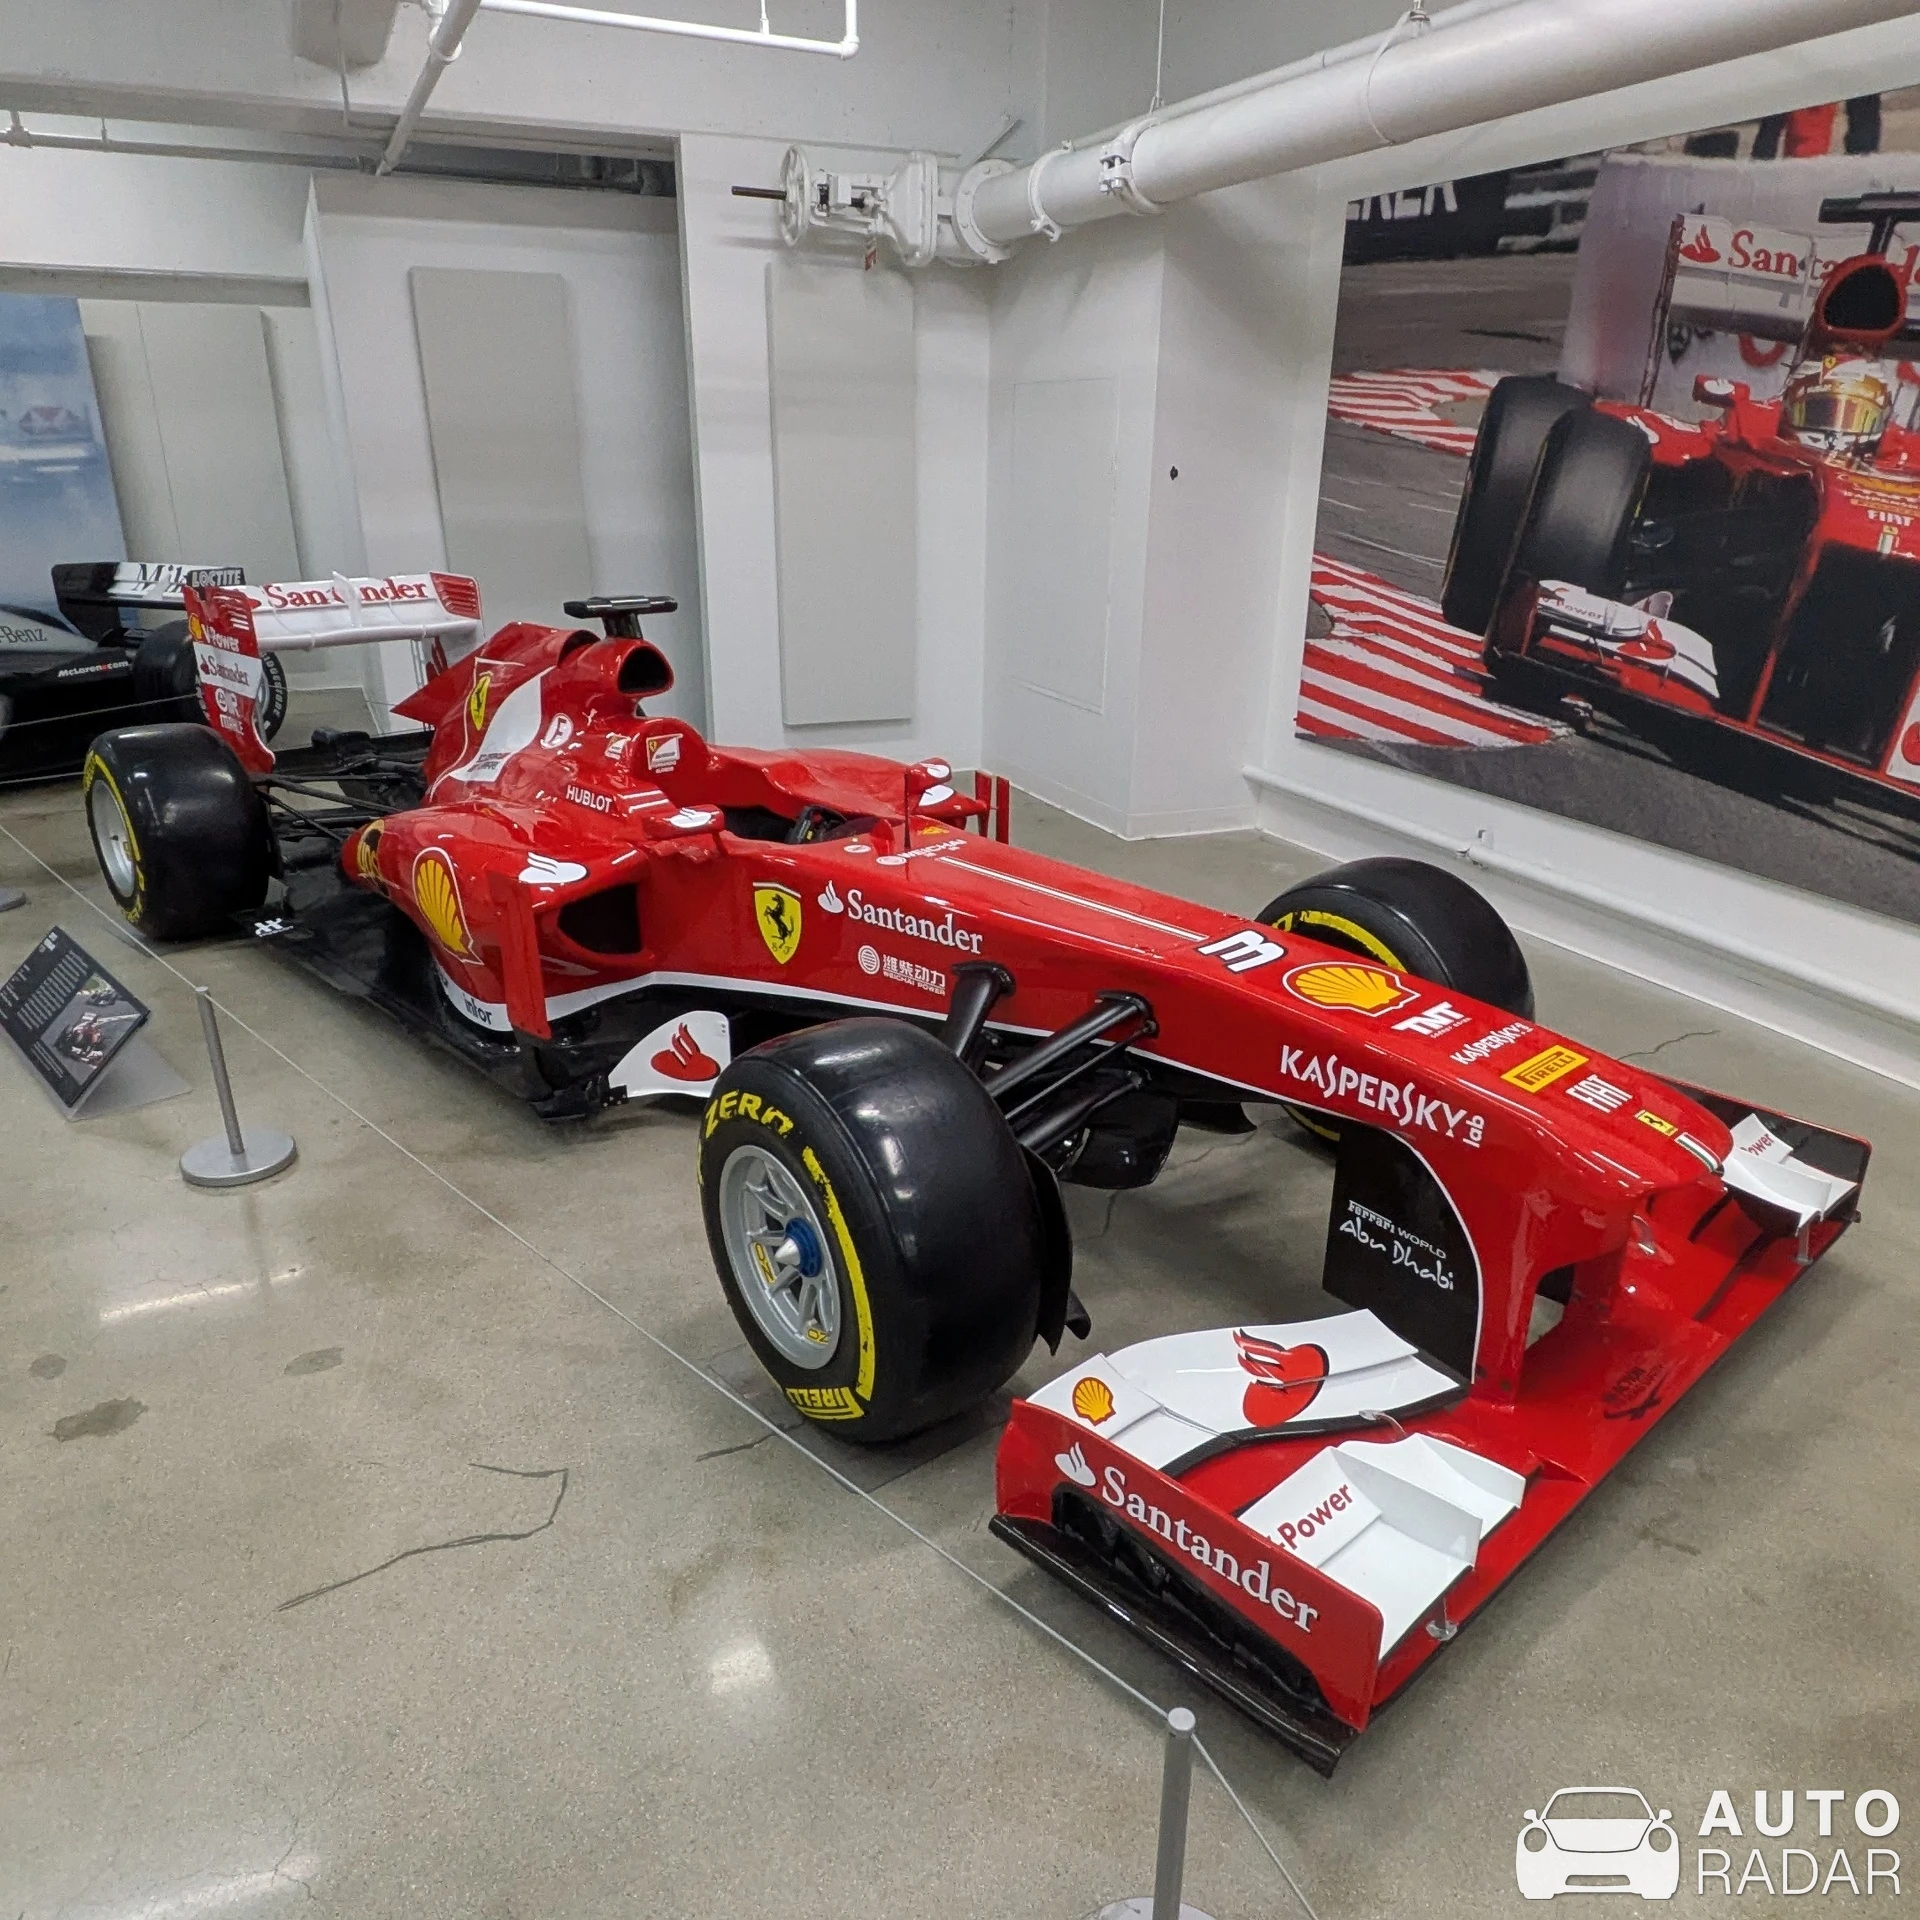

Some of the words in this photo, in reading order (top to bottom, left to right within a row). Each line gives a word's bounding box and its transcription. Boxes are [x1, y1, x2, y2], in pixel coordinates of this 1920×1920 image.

[192, 569, 241, 587] LOCTITE
[565, 784, 612, 813] HUBLOT
[847, 888, 983, 955] Santander
[1198, 929, 1287, 973] 3
[917, 982, 946, 996] POWER
[1391, 1001, 1465, 1035] TNT
[1514, 1051, 1577, 1086] PIRELLI
[1280, 1045, 1467, 1138] KASPERSKY
[1463, 1115, 1485, 1149] lab
[1566, 1074, 1633, 1113] FIAT
[1348, 1200, 1394, 1234] Ferrari
[1398, 1227, 1447, 1259] WORLD
[1339, 1217, 1387, 1251] Abu
[1392, 1240, 1454, 1290] Dhabi
[786, 1387, 864, 1420] PIRELLI
[1102, 1465, 1319, 1634] Santander
